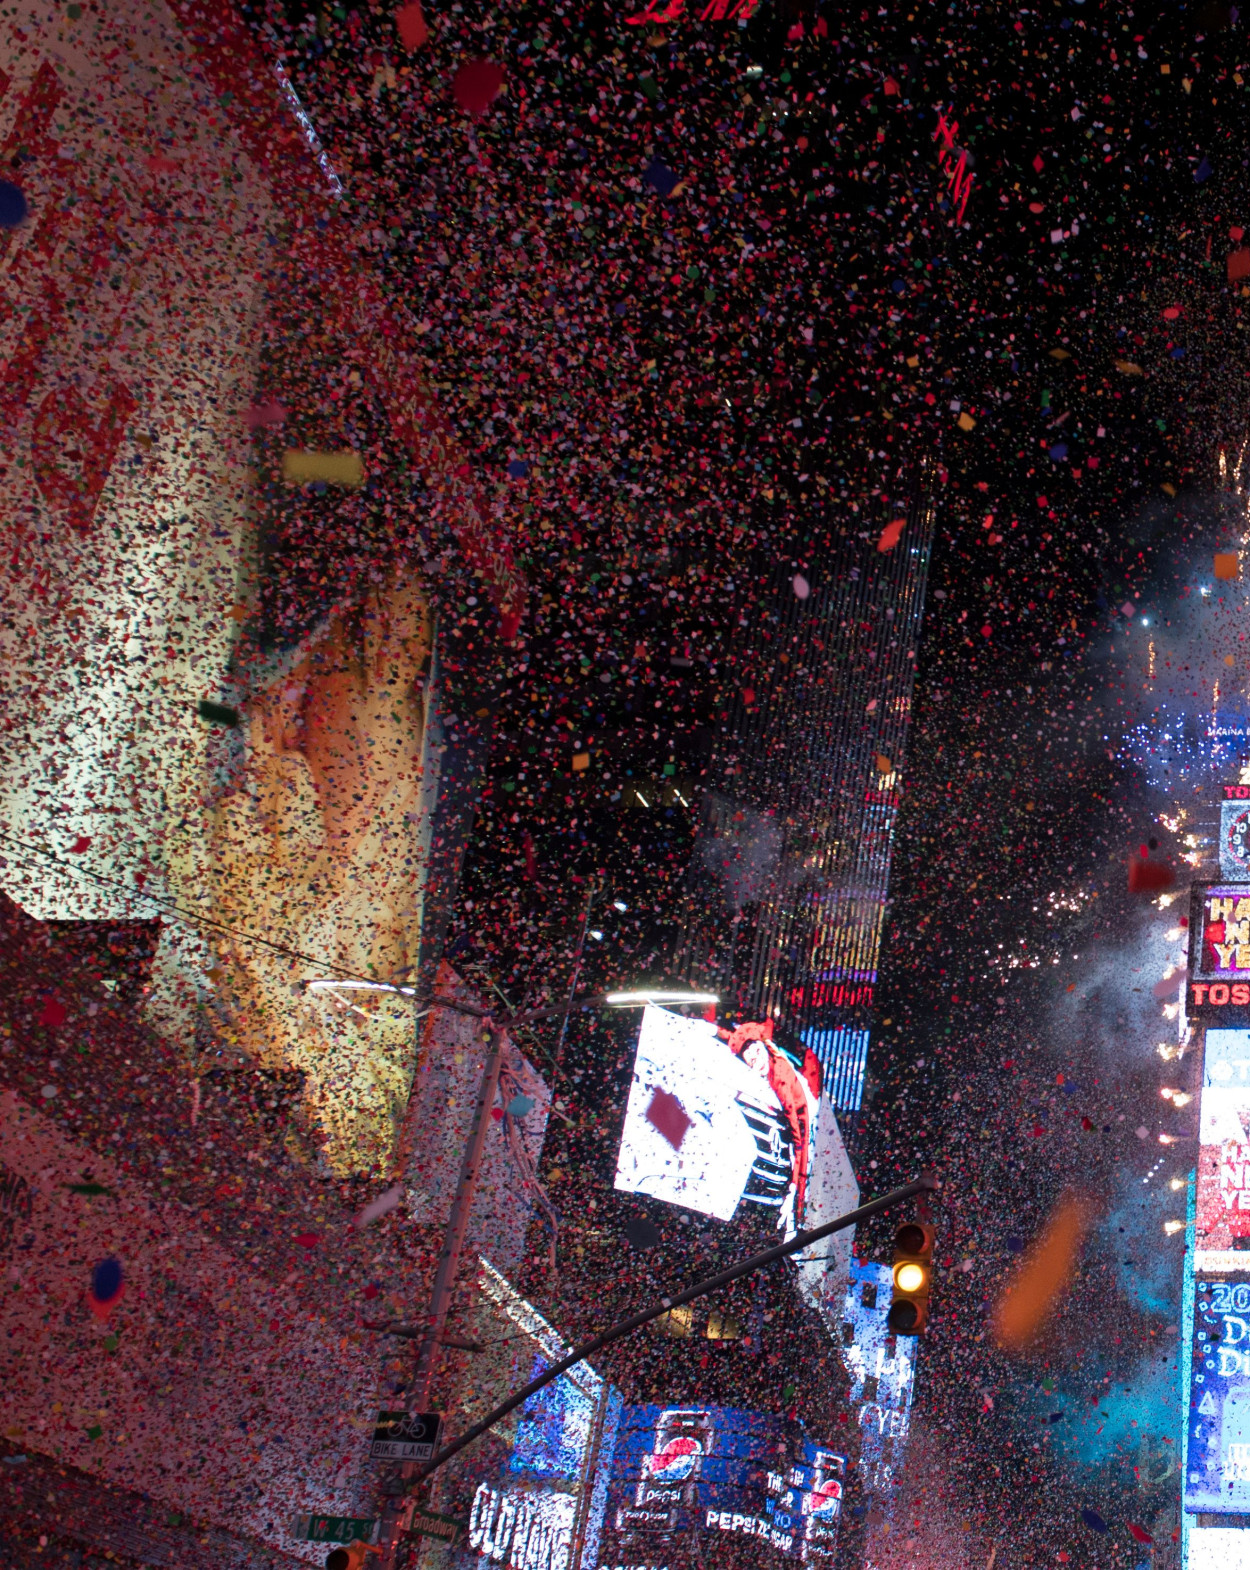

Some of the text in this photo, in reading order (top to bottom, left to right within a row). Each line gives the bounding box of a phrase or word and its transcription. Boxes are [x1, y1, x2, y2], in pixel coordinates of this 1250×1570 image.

[373, 1441, 431, 1457] BIKE LANE
[314, 1519, 327, 1538] W
[335, 1521, 355, 1539] 45
[413, 1511, 459, 1543] Broadway
[706, 1510, 757, 1535] PEPSI
